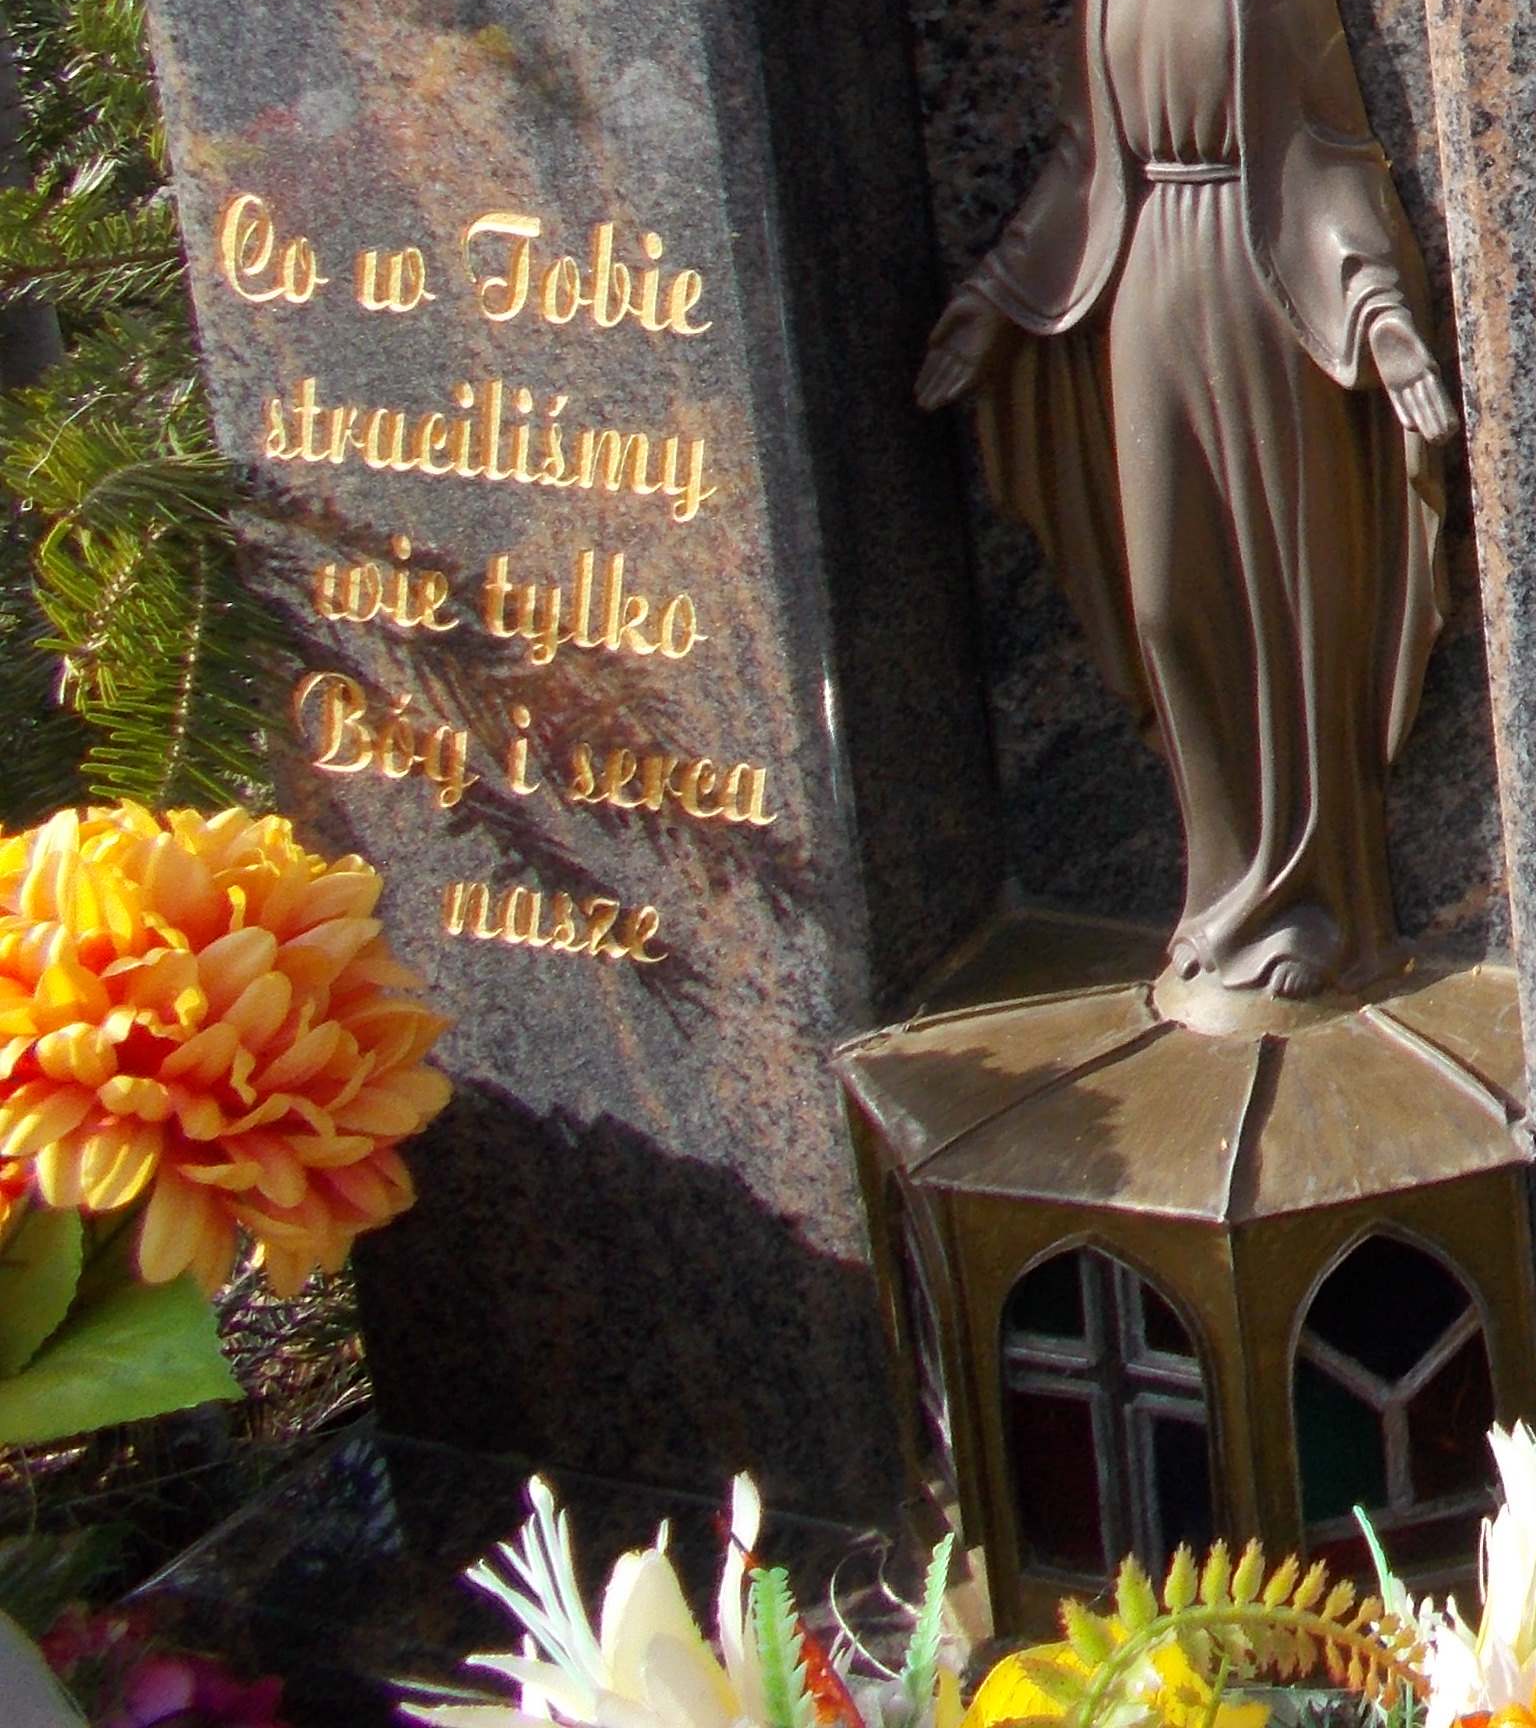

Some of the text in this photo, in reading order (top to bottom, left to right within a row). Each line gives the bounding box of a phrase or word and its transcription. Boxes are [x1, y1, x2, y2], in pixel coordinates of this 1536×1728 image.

[220, 192, 714, 336] Co w Tobie
[262, 376, 718, 524] straciliśmy
[484, 547, 710, 668] tylko
[292, 671, 778, 826] Bóg i serca
[441, 878, 670, 964] nasze
